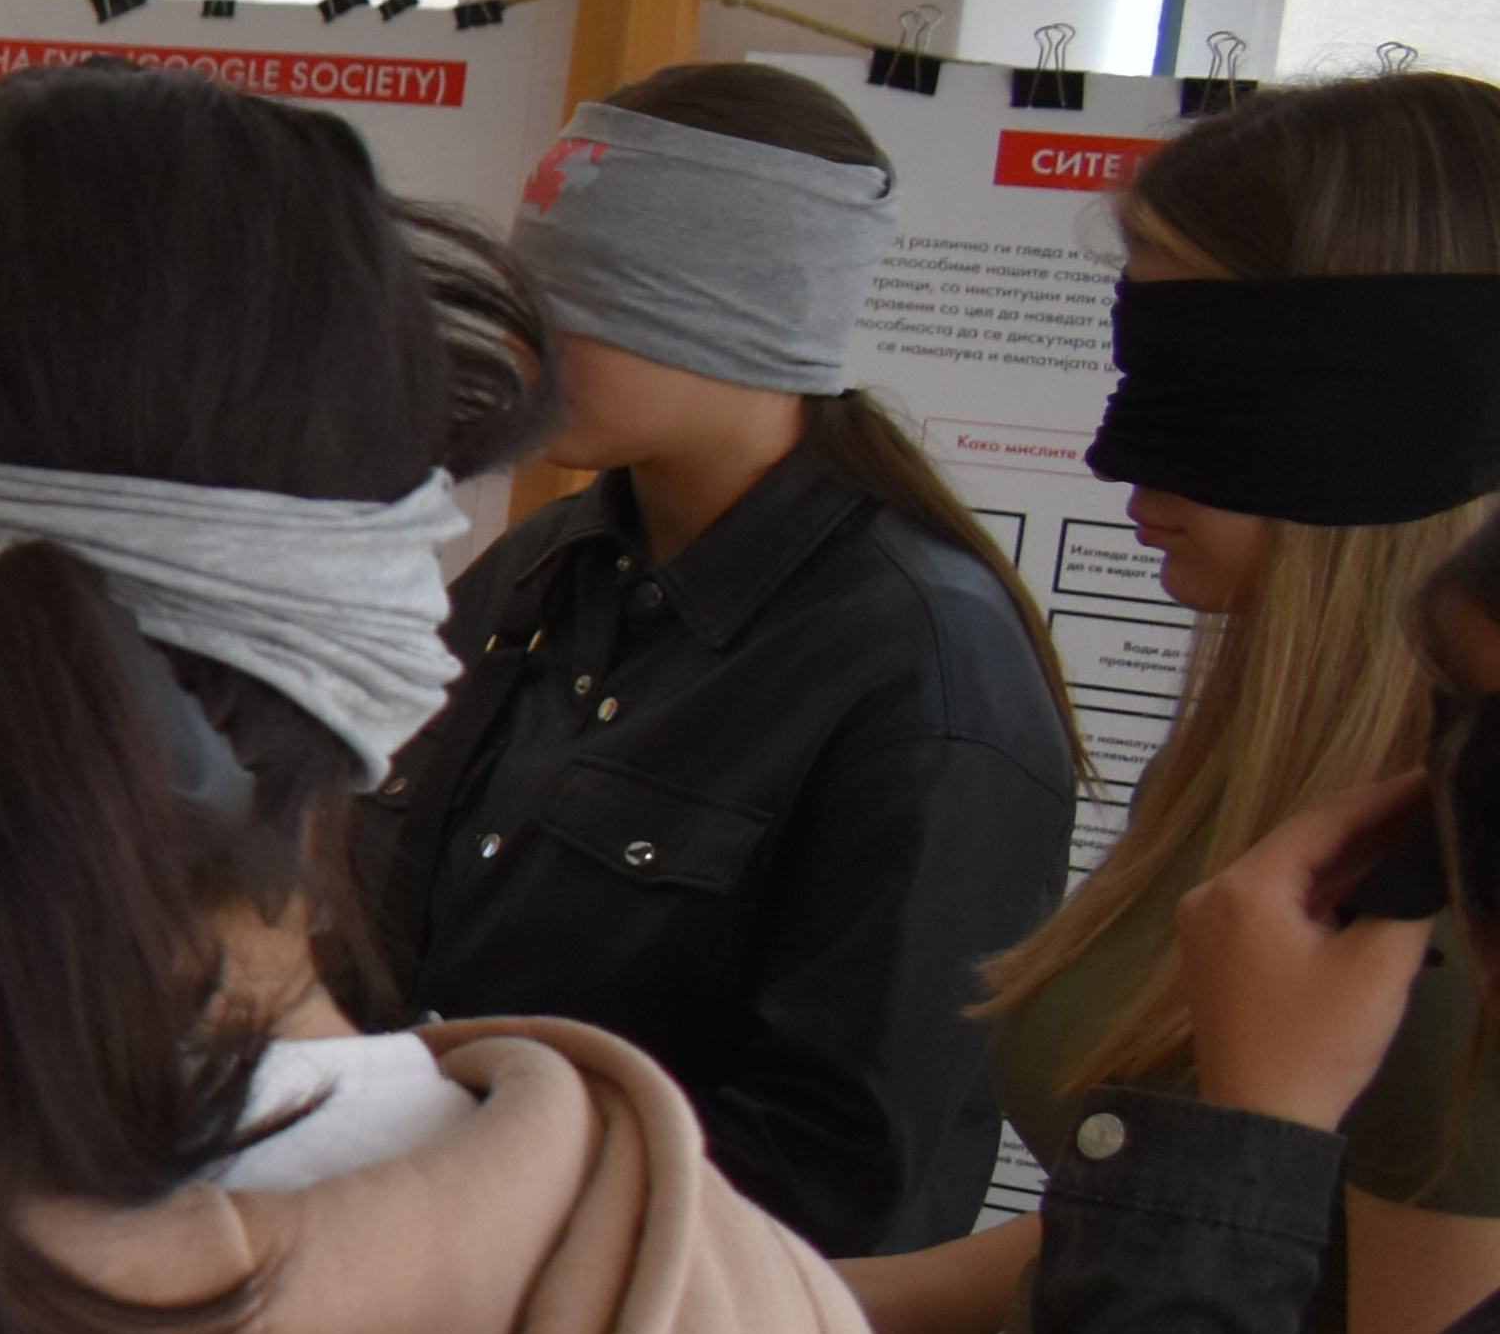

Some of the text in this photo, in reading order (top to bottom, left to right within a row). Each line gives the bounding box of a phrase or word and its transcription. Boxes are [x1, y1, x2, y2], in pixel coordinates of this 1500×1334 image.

[290, 60, 446, 105] SOCIETY)
[1031, 148, 1121, 178] СИТЕ
[910, 236, 989, 253] различно
[994, 243, 1011, 254] ги
[1017, 245, 1063, 260] гледа
[986, 266, 1049, 279] нашите
[941, 282, 960, 294] со
[965, 284, 1060, 303] институции
[1066, 293, 1096, 305] или
[940, 304, 959, 315] со
[965, 307, 994, 319] цел
[997, 309, 1019, 321] да
[1024, 311, 1093, 327] наведат
[957, 327, 978, 339] да
[983, 328, 1002, 340] се
[1006, 331, 1096, 351] дискутира
[877, 341, 896, 352] се
[901, 343, 983, 362] намалува
[1003, 352, 1099, 372] емпатијата
[957, 433, 1077, 460] Како мислите
